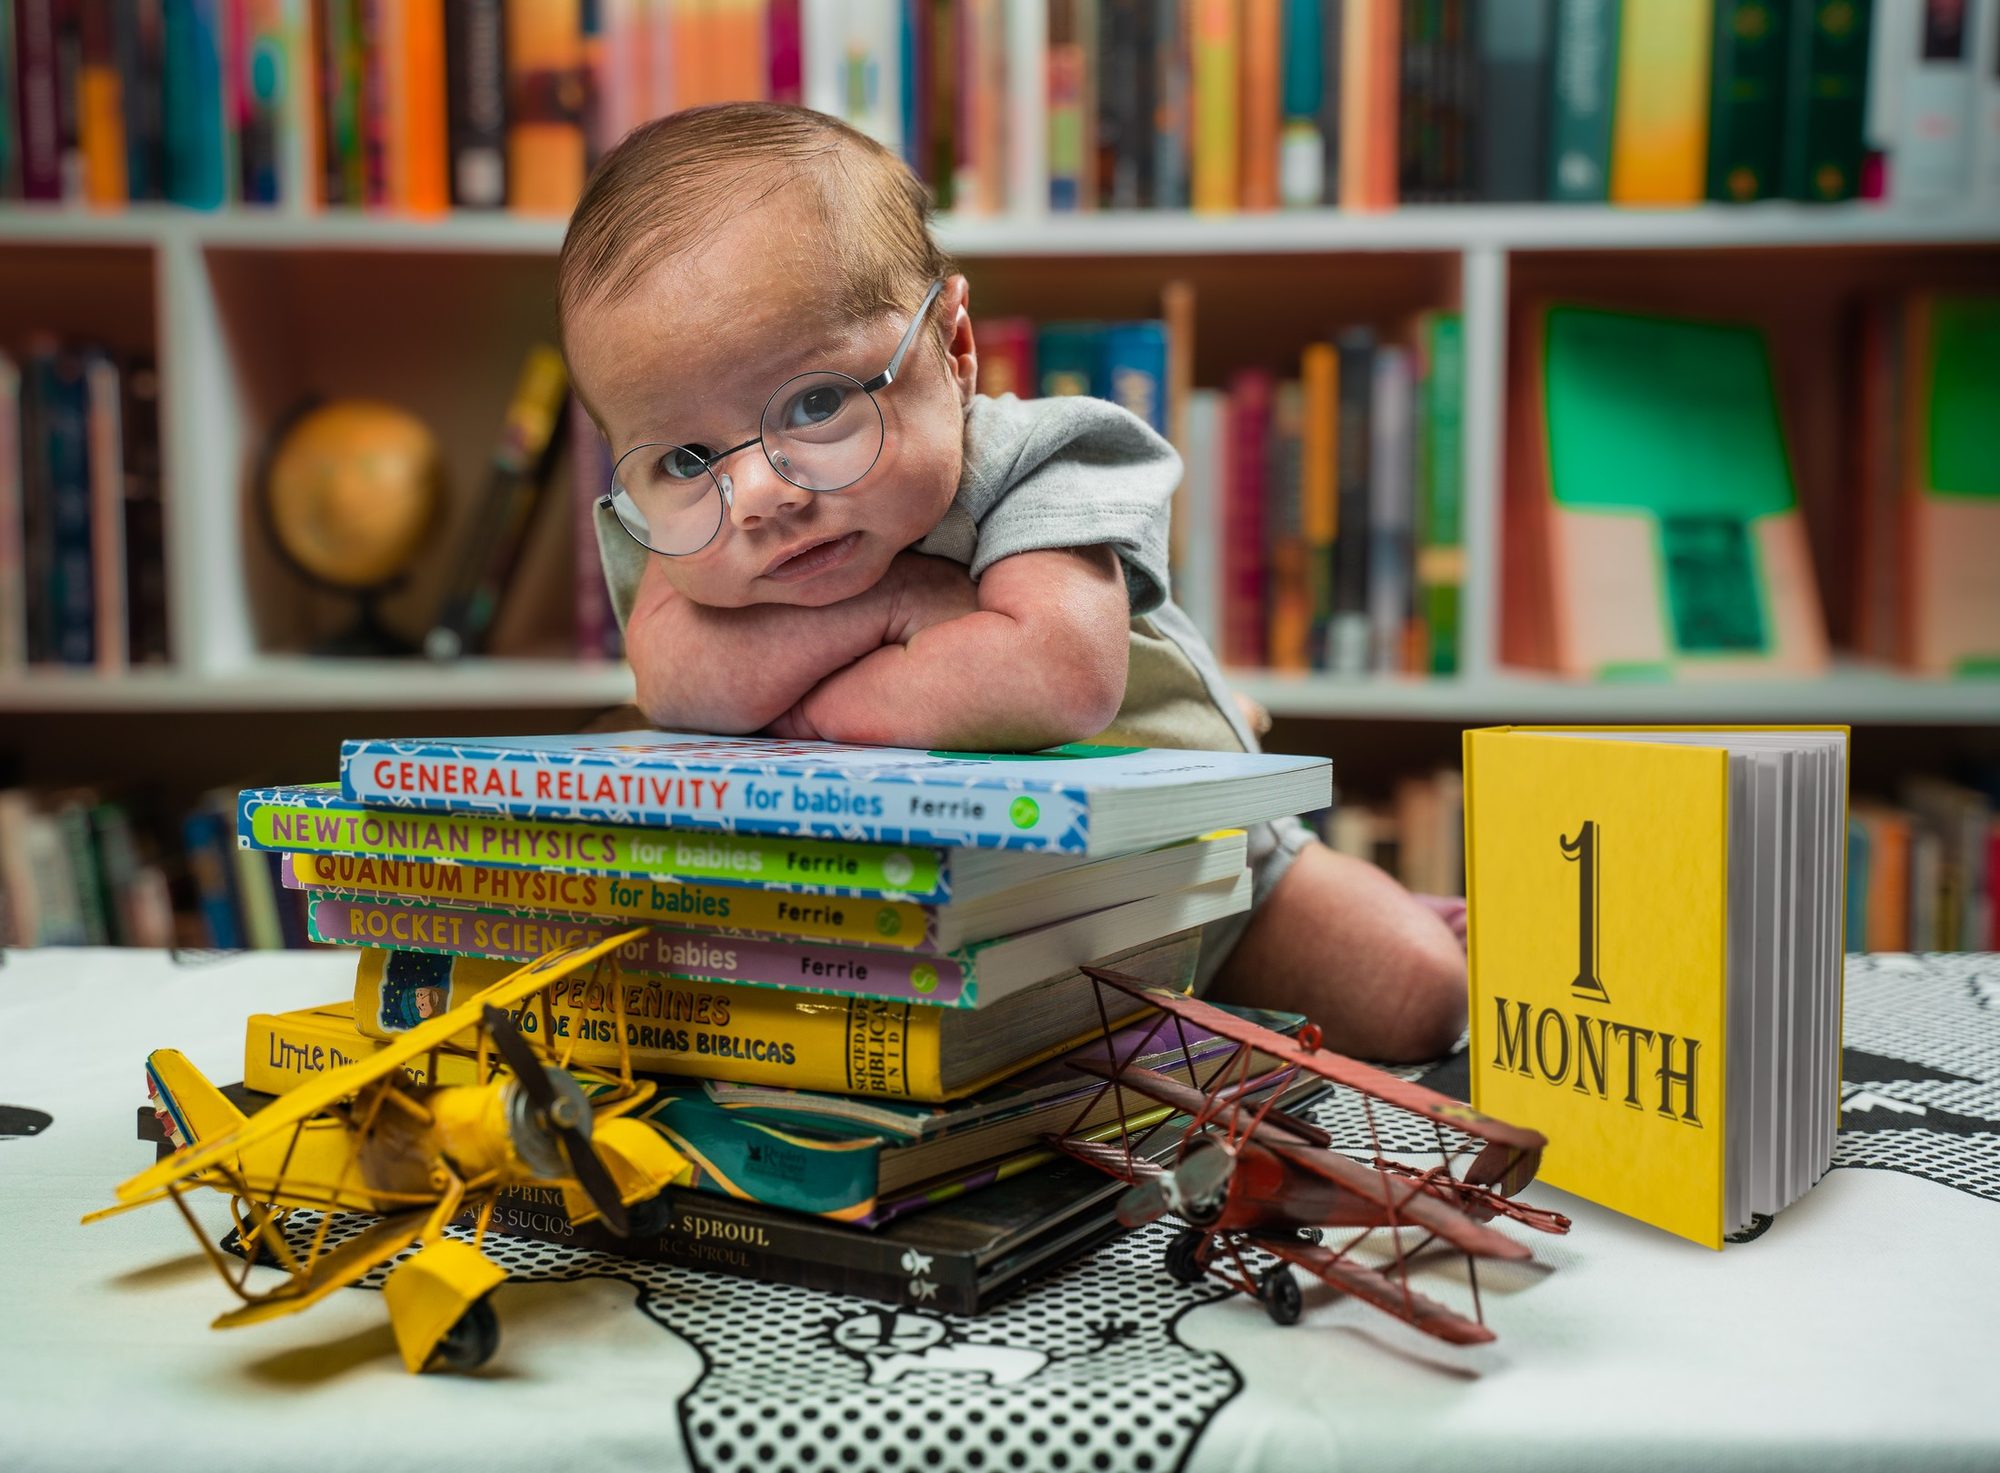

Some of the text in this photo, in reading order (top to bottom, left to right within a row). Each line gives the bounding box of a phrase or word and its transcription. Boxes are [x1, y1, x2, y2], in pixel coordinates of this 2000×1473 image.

[374, 760, 986, 820] GENERAL RELATIVITY for babies Ferrie
[272, 812, 860, 875] NEWTONIAN PHYSICS for babies Ferrie
[315, 855, 845, 926] QUANTUM PHYSICS for babies Ferrie
[1559, 820, 1611, 1004] 1
[350, 908, 464, 944] ROCKET
[656, 937, 738, 970] babies
[801, 956, 869, 981] Ferrie
[577, 1017, 690, 1051] HISTORIAS
[695, 1032, 796, 1065] BIBLICAS
[1491, 996, 1704, 1129] MONTH
[507, 1208, 576, 1238] SUCIOS
[682, 1215, 770, 1247] SPROUL
[688, 1242, 750, 1268] SPROUL
